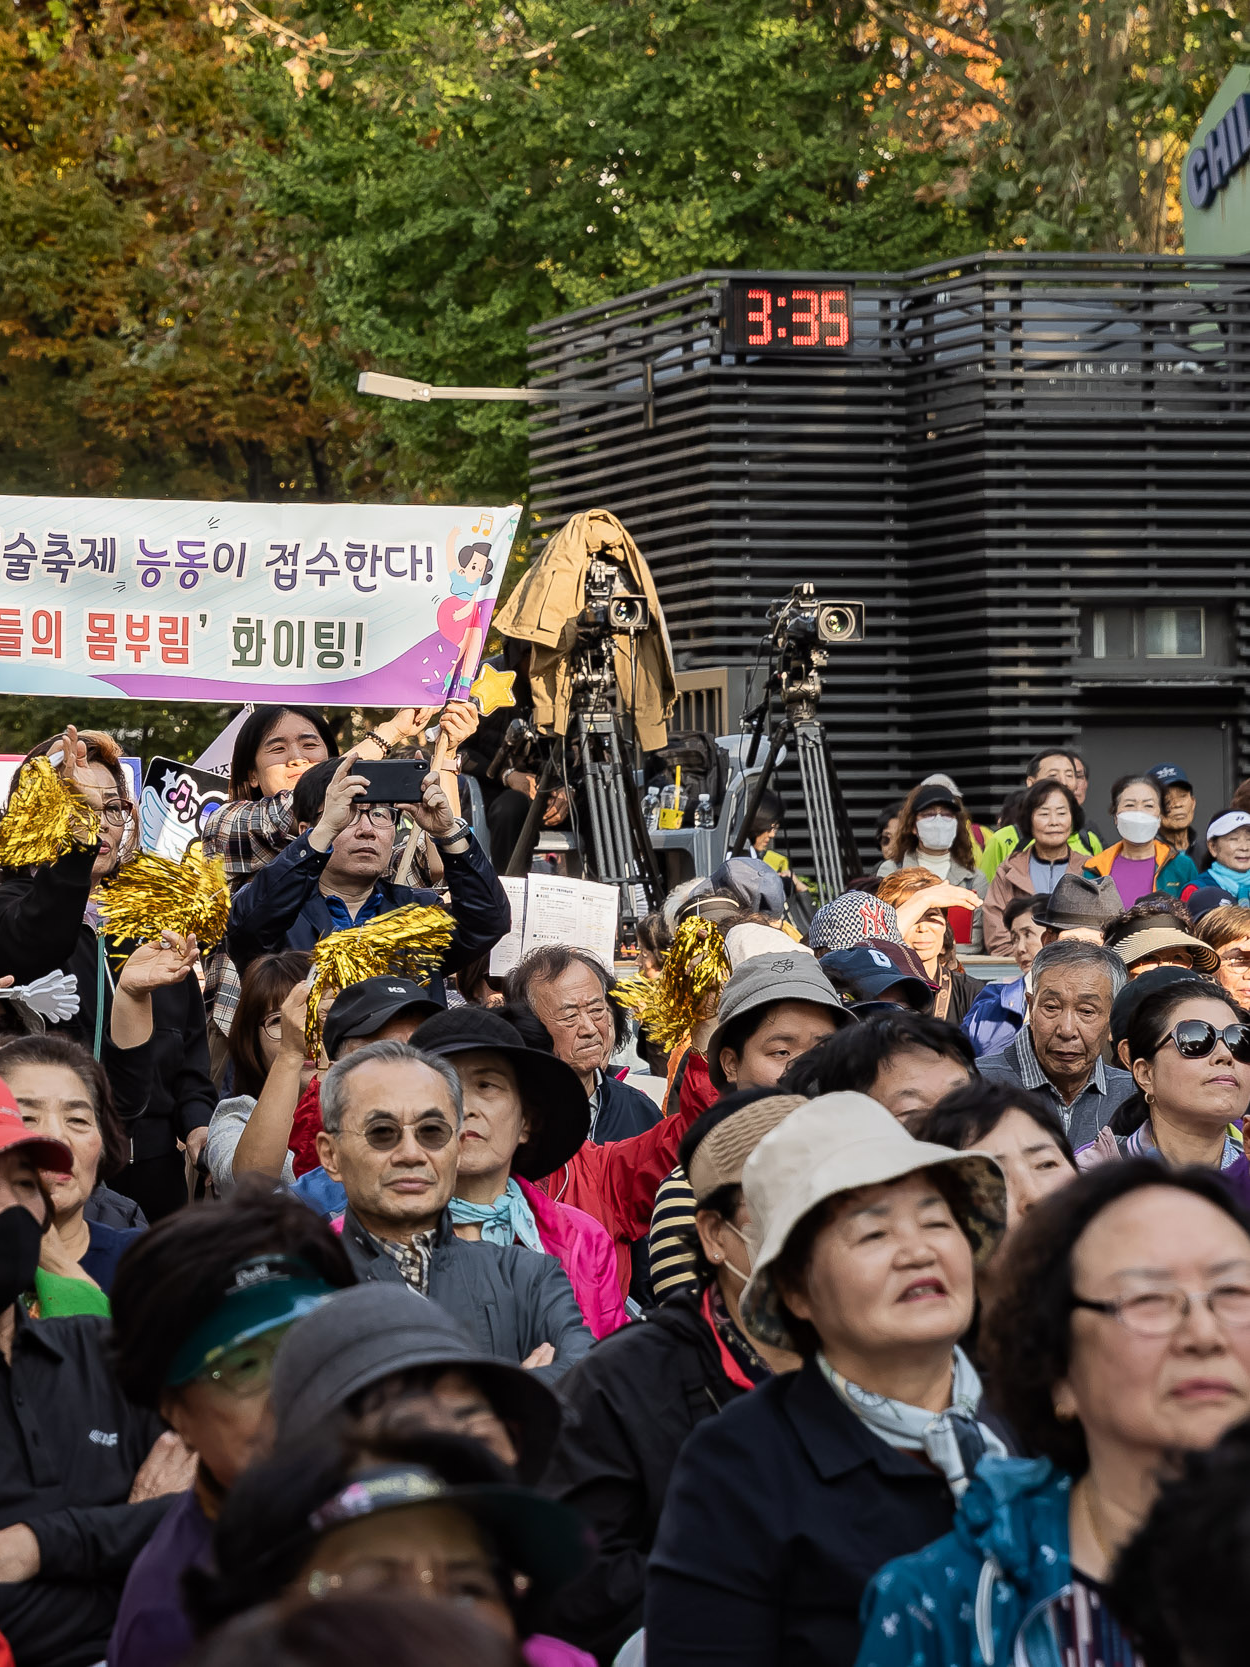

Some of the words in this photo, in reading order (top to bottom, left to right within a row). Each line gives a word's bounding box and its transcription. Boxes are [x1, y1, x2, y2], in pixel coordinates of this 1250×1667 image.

[748, 289, 849, 346] 3:35
[136, 539, 247, 589] 능동이
[265, 541, 434, 592] 접수한다!
[232, 616, 364, 669] 화이팅!
[859, 901, 889, 936] NY
